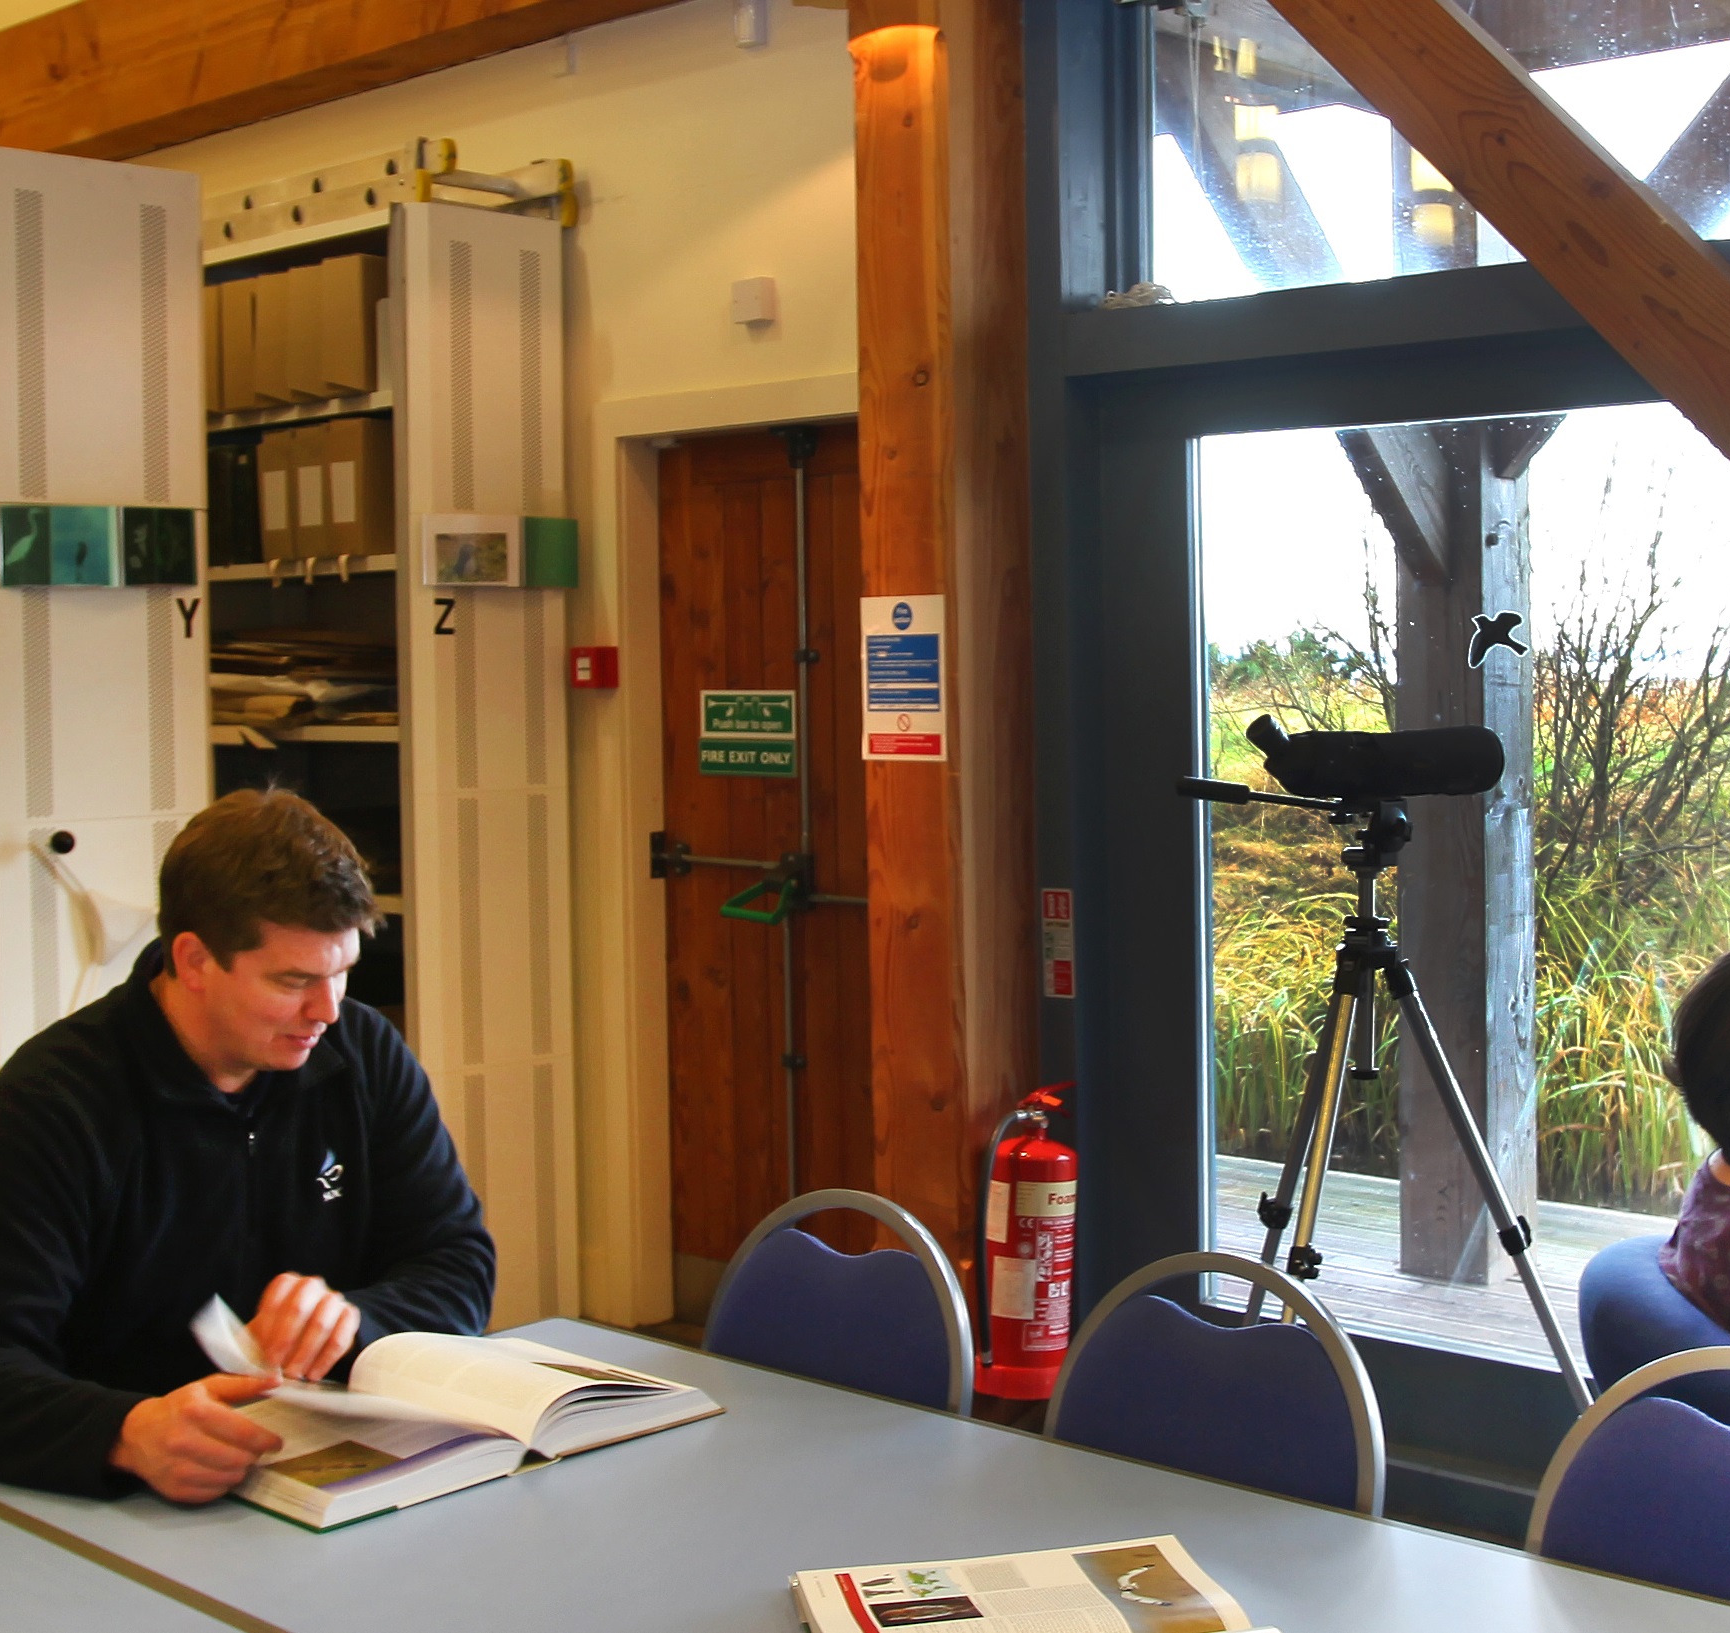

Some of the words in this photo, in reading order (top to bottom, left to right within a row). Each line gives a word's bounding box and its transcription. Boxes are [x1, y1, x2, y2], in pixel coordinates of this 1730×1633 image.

[176, 598, 201, 638] Y
[434, 598, 456, 635] Z
[701, 750, 726, 763] FIRE
[729, 751, 757, 764] EXIT
[759, 752, 791, 765] ONLY
